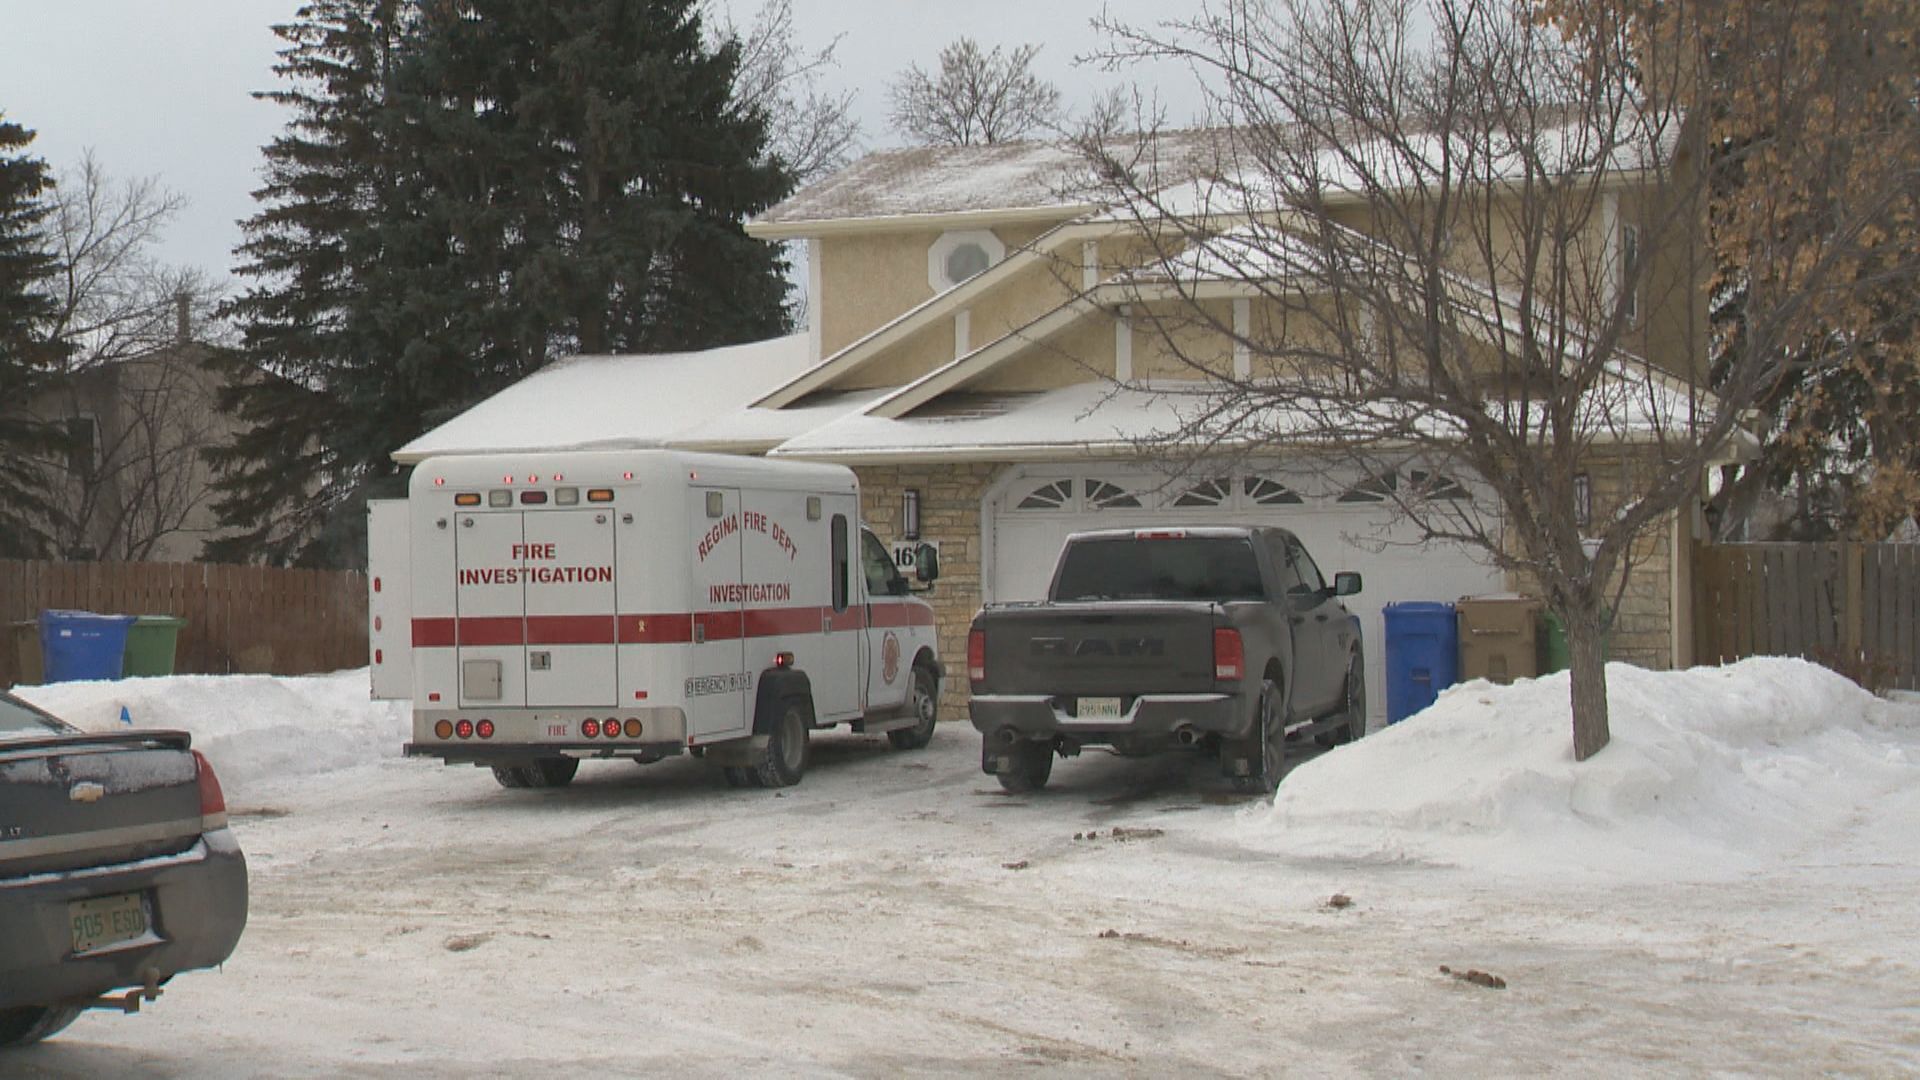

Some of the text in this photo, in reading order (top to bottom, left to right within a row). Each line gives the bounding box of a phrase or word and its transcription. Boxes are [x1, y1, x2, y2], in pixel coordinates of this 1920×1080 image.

[698, 511, 797, 562] REGINA FIRE DEPT
[512, 543, 556, 560] FIRE
[459, 566, 613, 585] INVESTIGATION
[709, 583, 790, 603] INVESTIGATION
[1030, 637, 1165, 657] RAM
[547, 725, 567, 737] FIRE
